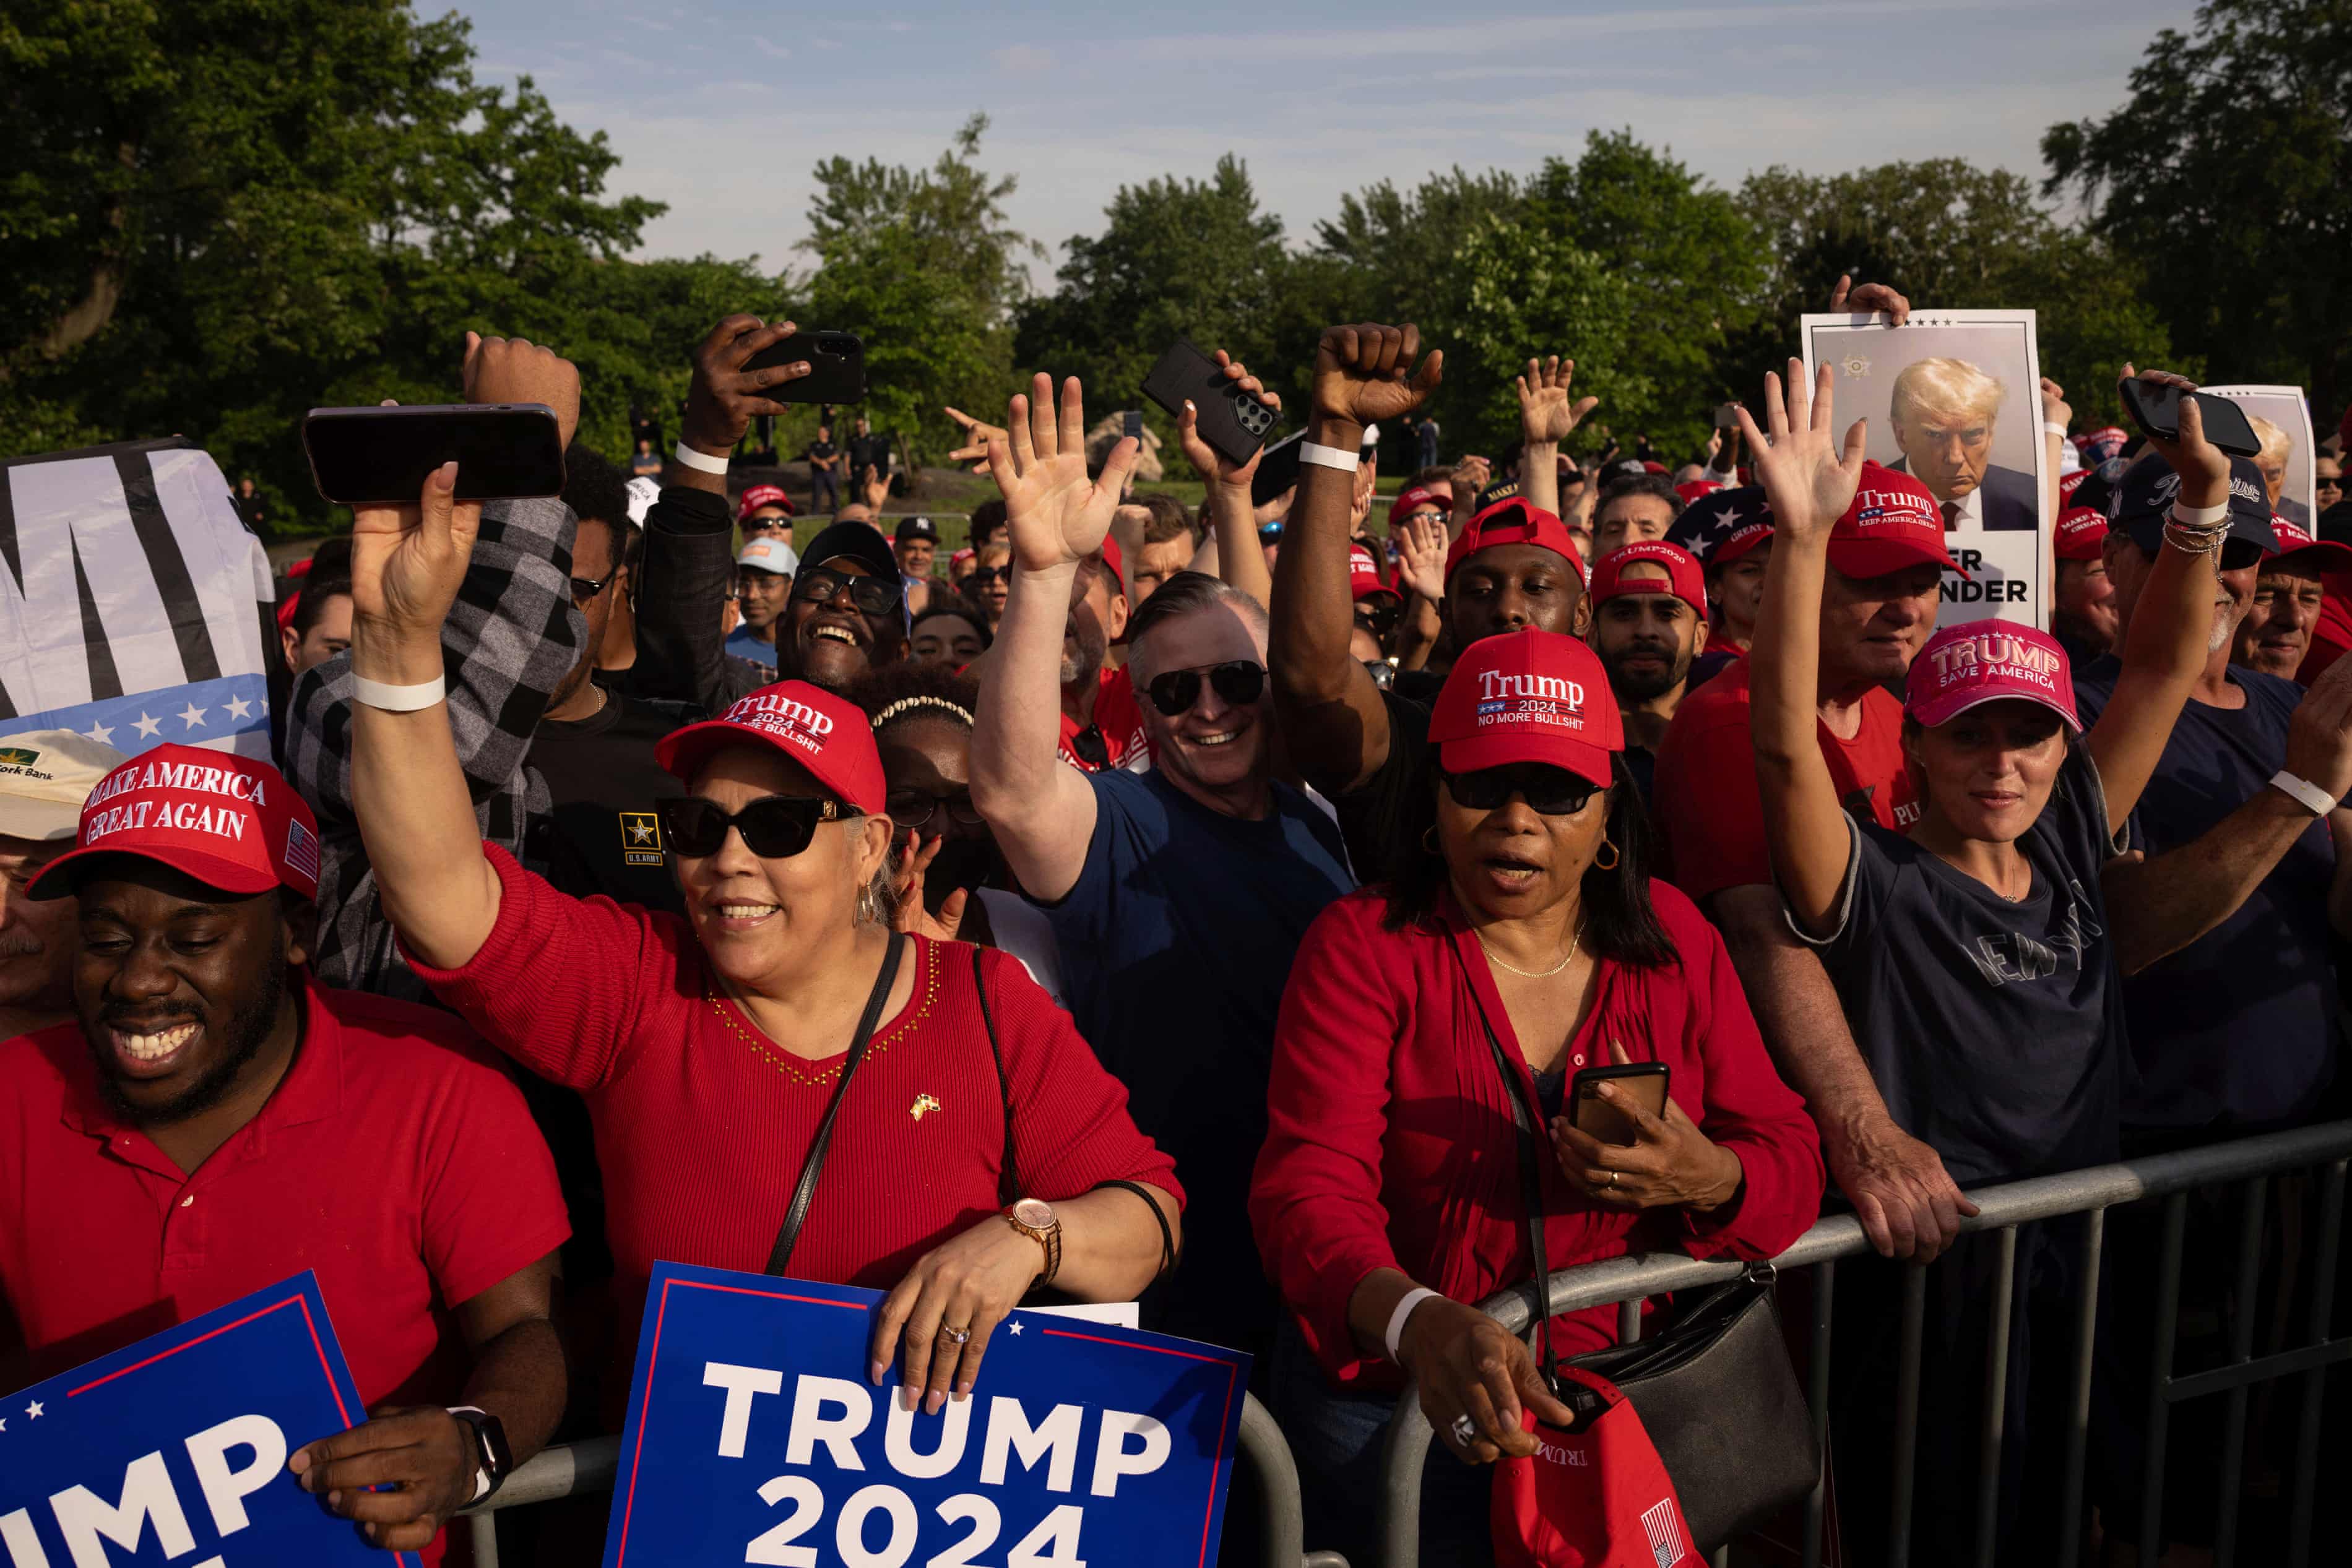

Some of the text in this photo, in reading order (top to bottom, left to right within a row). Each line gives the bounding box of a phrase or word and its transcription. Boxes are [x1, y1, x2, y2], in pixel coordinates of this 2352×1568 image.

[1857, 489, 1933, 516] Trump
[1859, 516, 1937, 530] KEEP AMERICA GREAT
[1940, 580, 2028, 603] NDER
[1930, 639, 2060, 677] TRUMP
[1477, 670, 1585, 712] Trump
[1940, 665, 2056, 693] SAVE AMERICA
[723, 694, 834, 737] Trump
[752, 712, 795, 730] 2024
[1518, 700, 1557, 714] 2024
[1478, 712, 1585, 731] NO MORE BULLSHIT
[764, 723, 823, 756] BULLSHIT
[0, 764, 54, 780] ork Bank
[84, 761, 267, 812] MAKE AMERICA
[85, 801, 248, 846] GREAT AGAIN
[701, 1361, 1172, 1497] TRUMP
[1535, 1441, 1588, 1467] TRUM
[744, 1475, 1087, 1568] 2024
